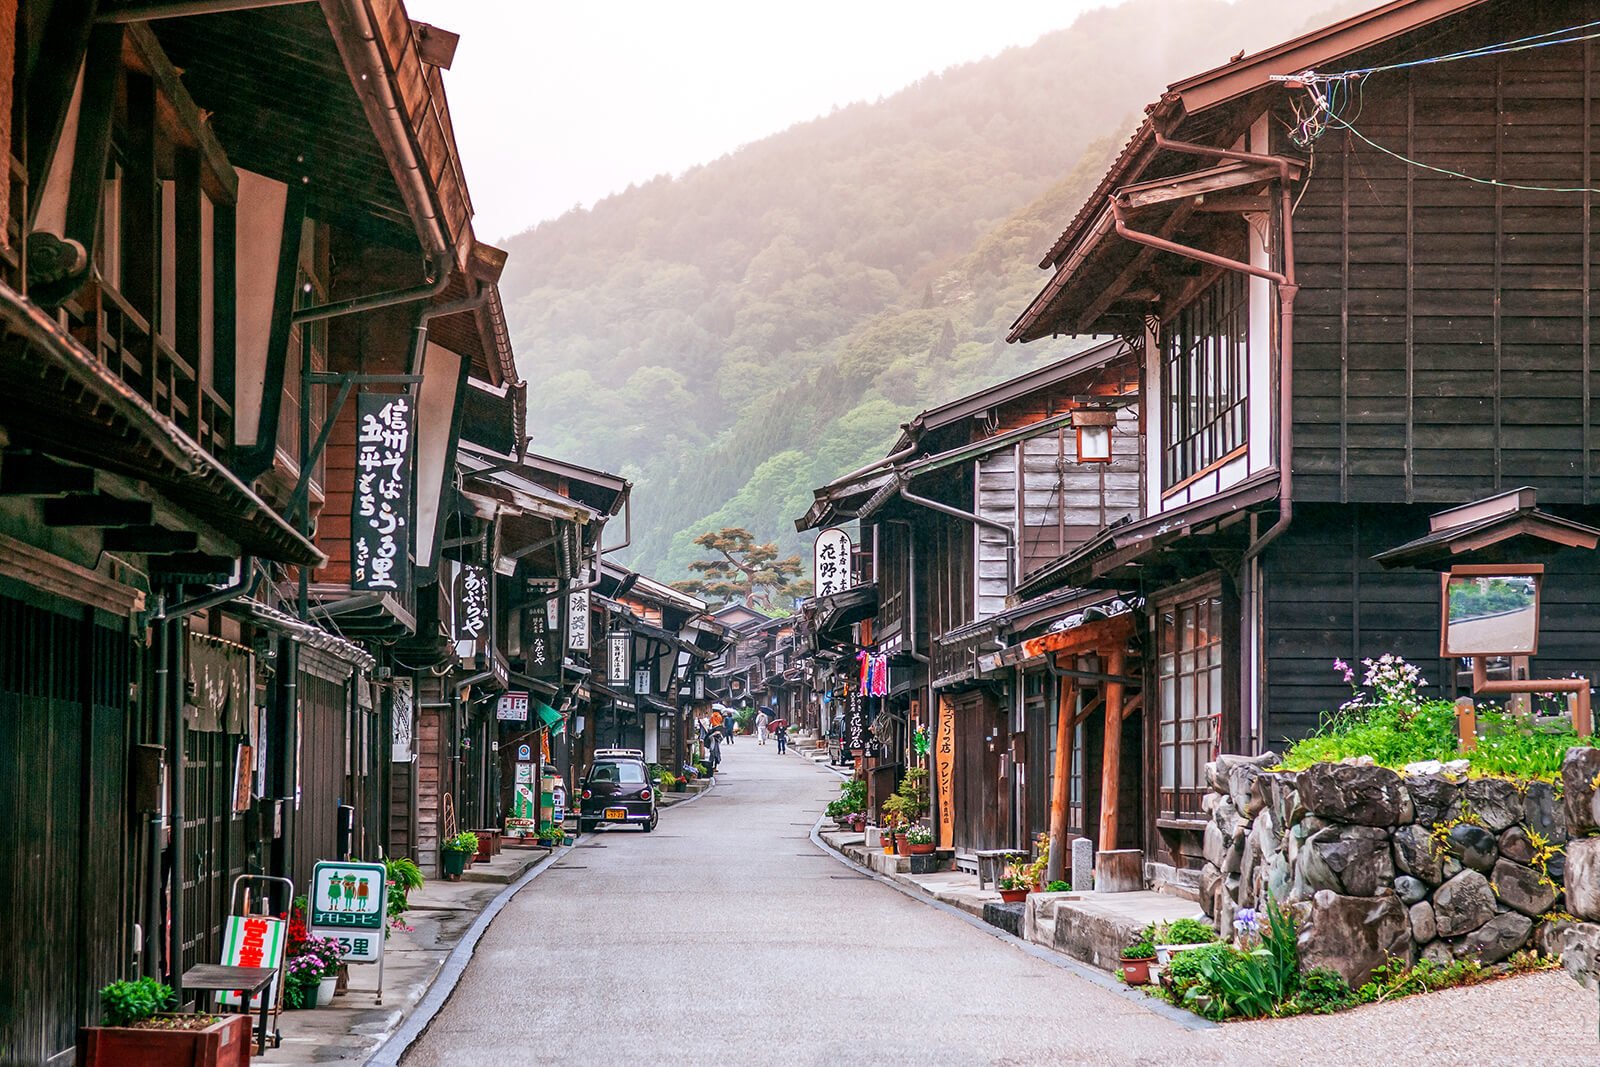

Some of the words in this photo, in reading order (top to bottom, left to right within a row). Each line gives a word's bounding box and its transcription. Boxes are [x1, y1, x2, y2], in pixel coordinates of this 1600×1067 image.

[820, 543, 838, 597] 花野屋
[462, 571, 484, 638] あぶらや
